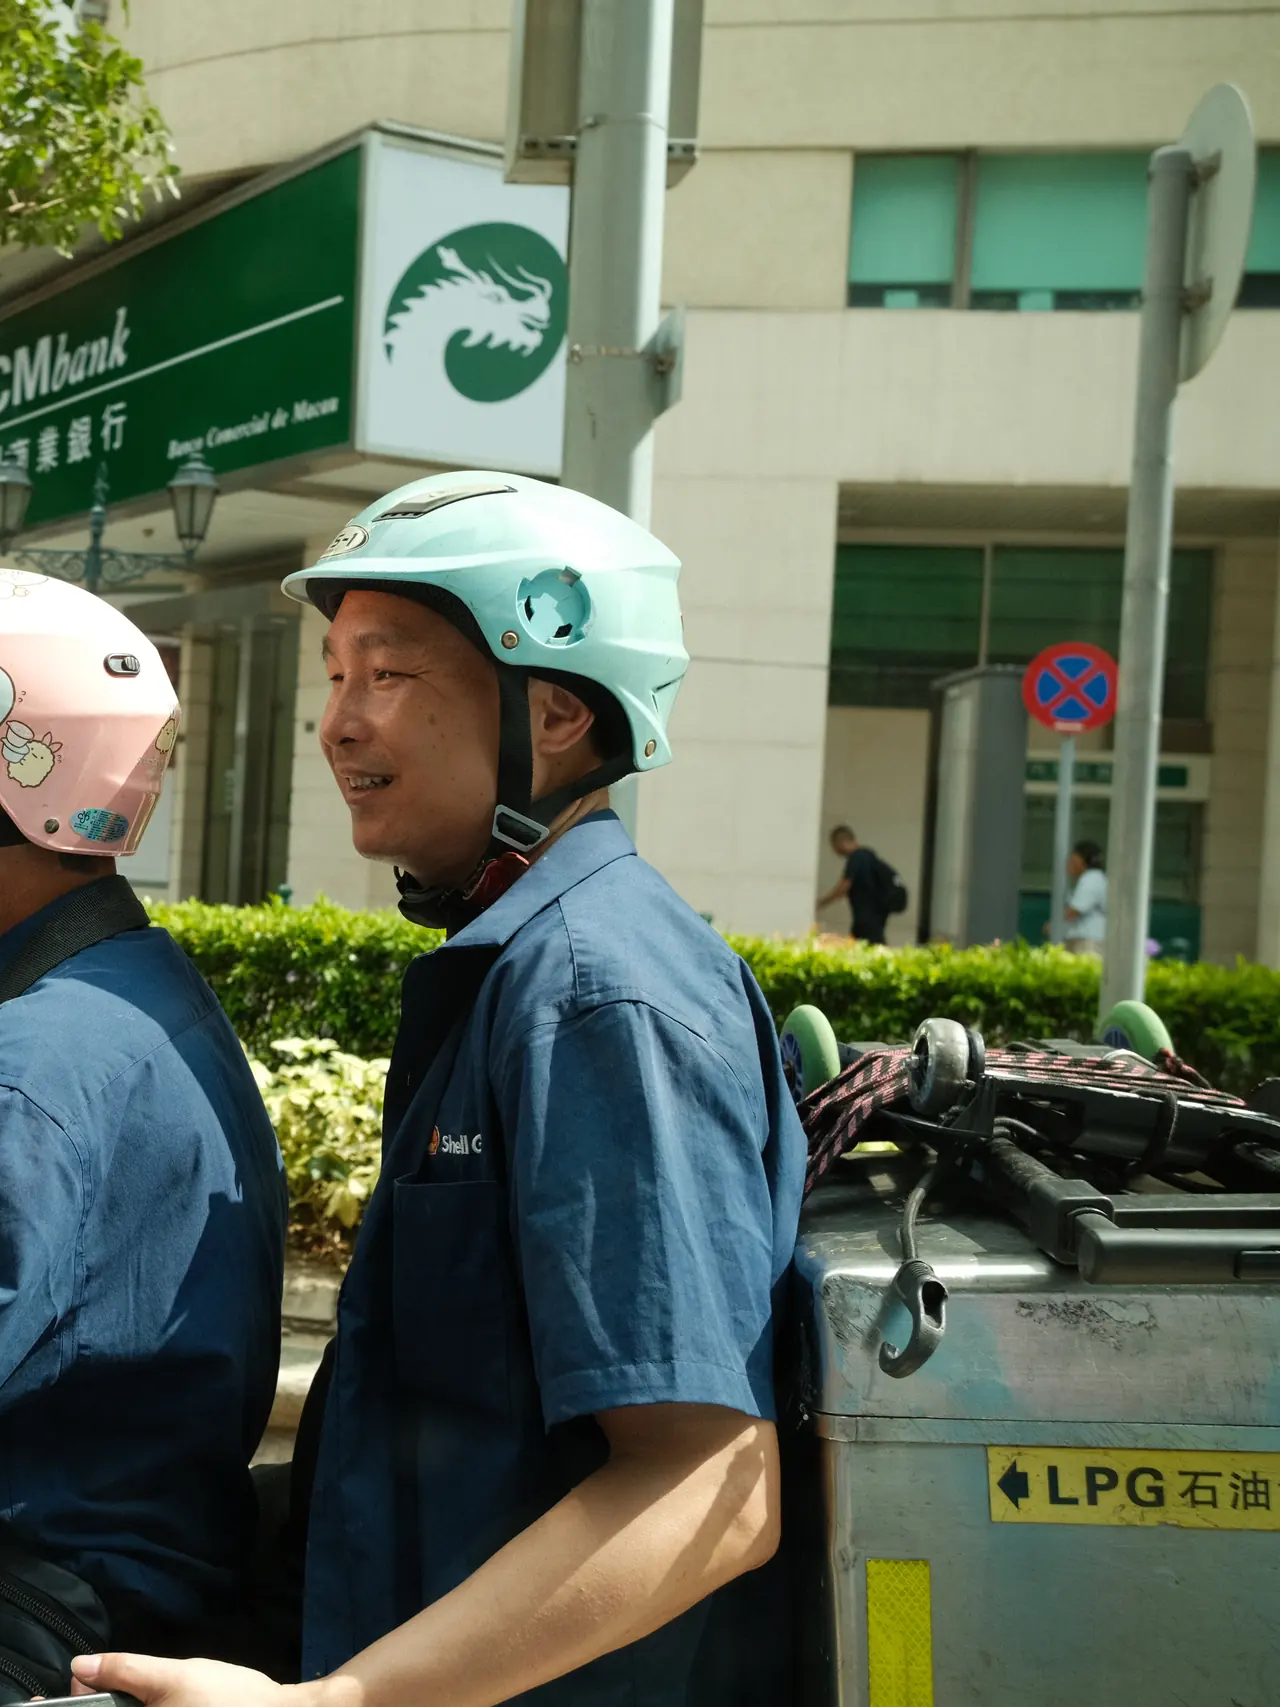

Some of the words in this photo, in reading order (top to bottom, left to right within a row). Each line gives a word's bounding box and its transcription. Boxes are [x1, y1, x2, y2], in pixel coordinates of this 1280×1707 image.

[206, 411, 270, 448] Comercial
[271, 407, 289, 430] de
[441, 1134, 470, 1155] Shell
[1047, 1465, 1165, 1508] LPG
